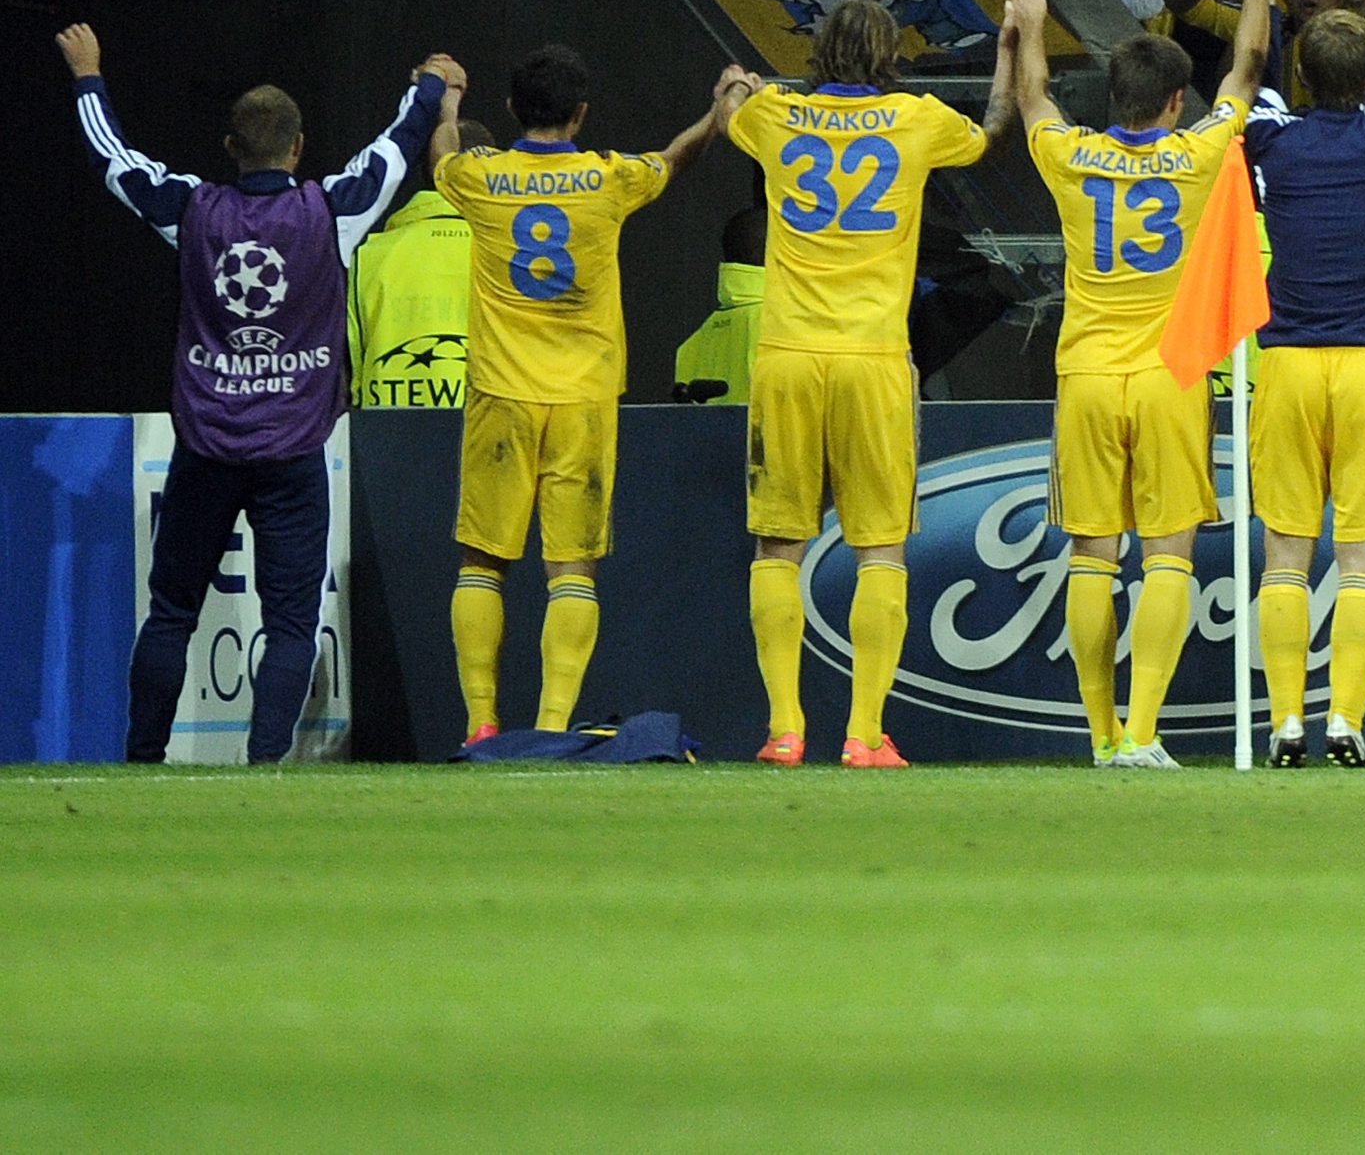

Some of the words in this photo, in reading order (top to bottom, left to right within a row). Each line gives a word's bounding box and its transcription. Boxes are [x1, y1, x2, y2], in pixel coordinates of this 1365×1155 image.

[786, 106, 898, 130] SIVAKOV
[485, 169, 605, 196] VALADZKO
[779, 133, 901, 233] 32
[1081, 175, 1184, 273] 13
[509, 202, 576, 302] 8
[229, 330, 280, 351] UEFA
[214, 376, 296, 395] LEAGUE
[369, 378, 462, 408] STEW
